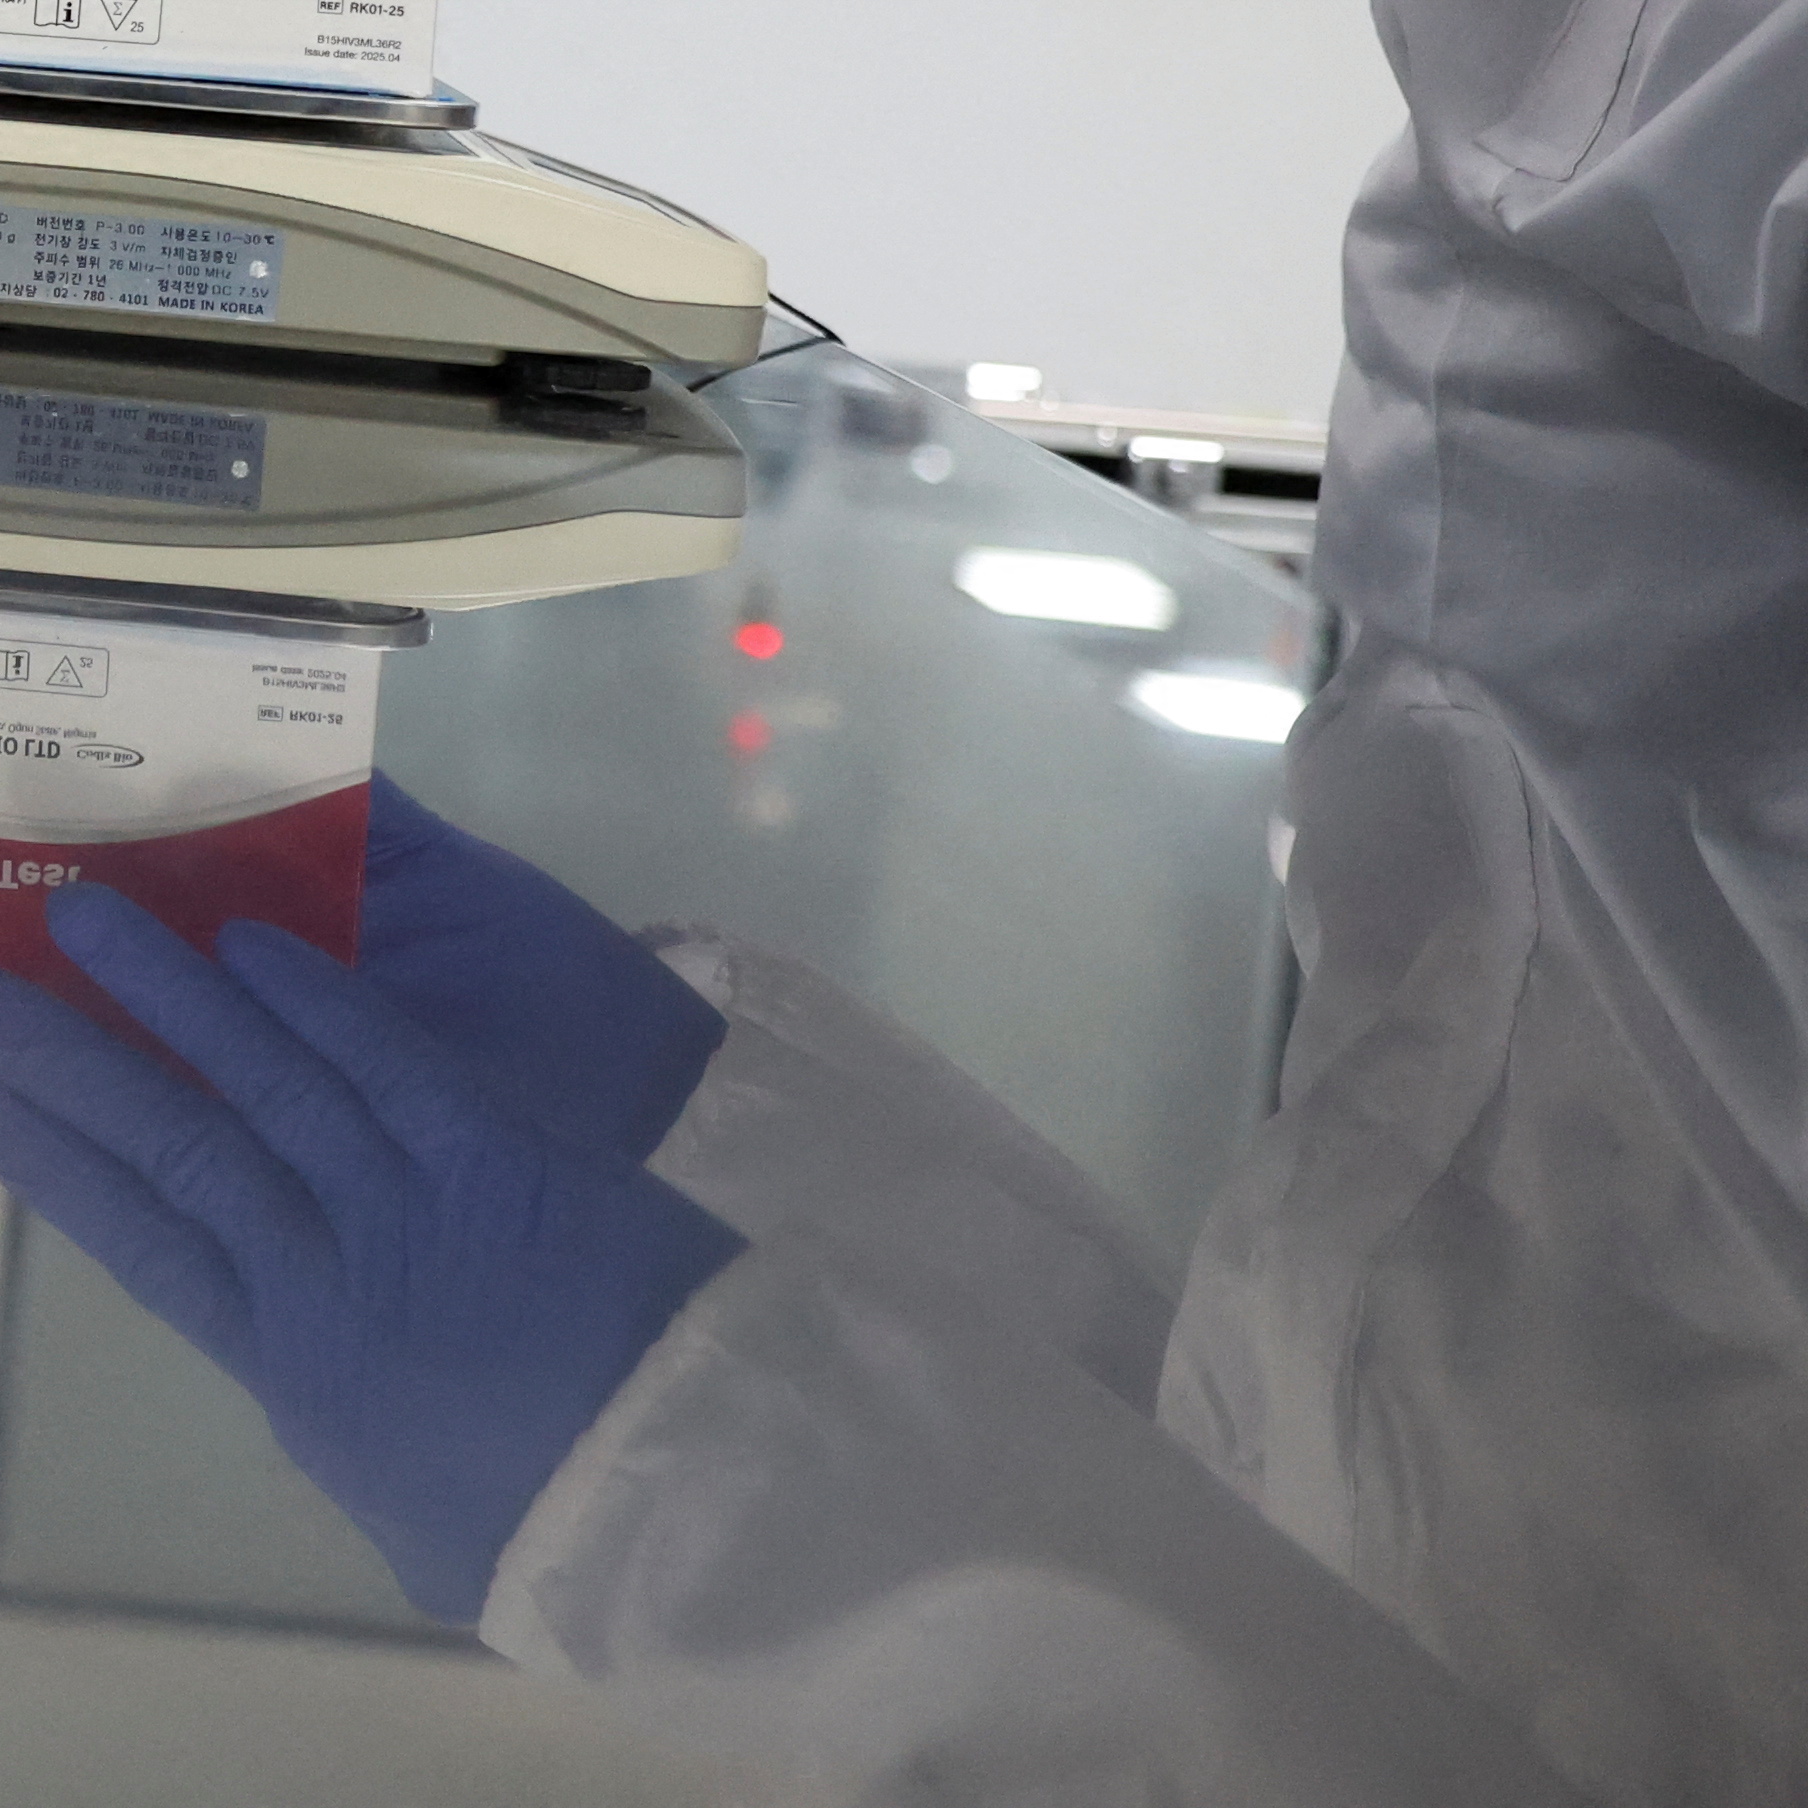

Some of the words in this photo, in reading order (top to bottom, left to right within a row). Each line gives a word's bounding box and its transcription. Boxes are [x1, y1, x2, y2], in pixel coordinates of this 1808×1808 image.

[320, 1, 341, 11] REF
[349, 2, 405, 17] RK01-25
[130, 21, 144, 33] 25
[304, 47, 330, 58] Issue
[158, 296, 196, 310] MADE
[201, 299, 214, 311] IN
[220, 302, 264, 315] KOREA
